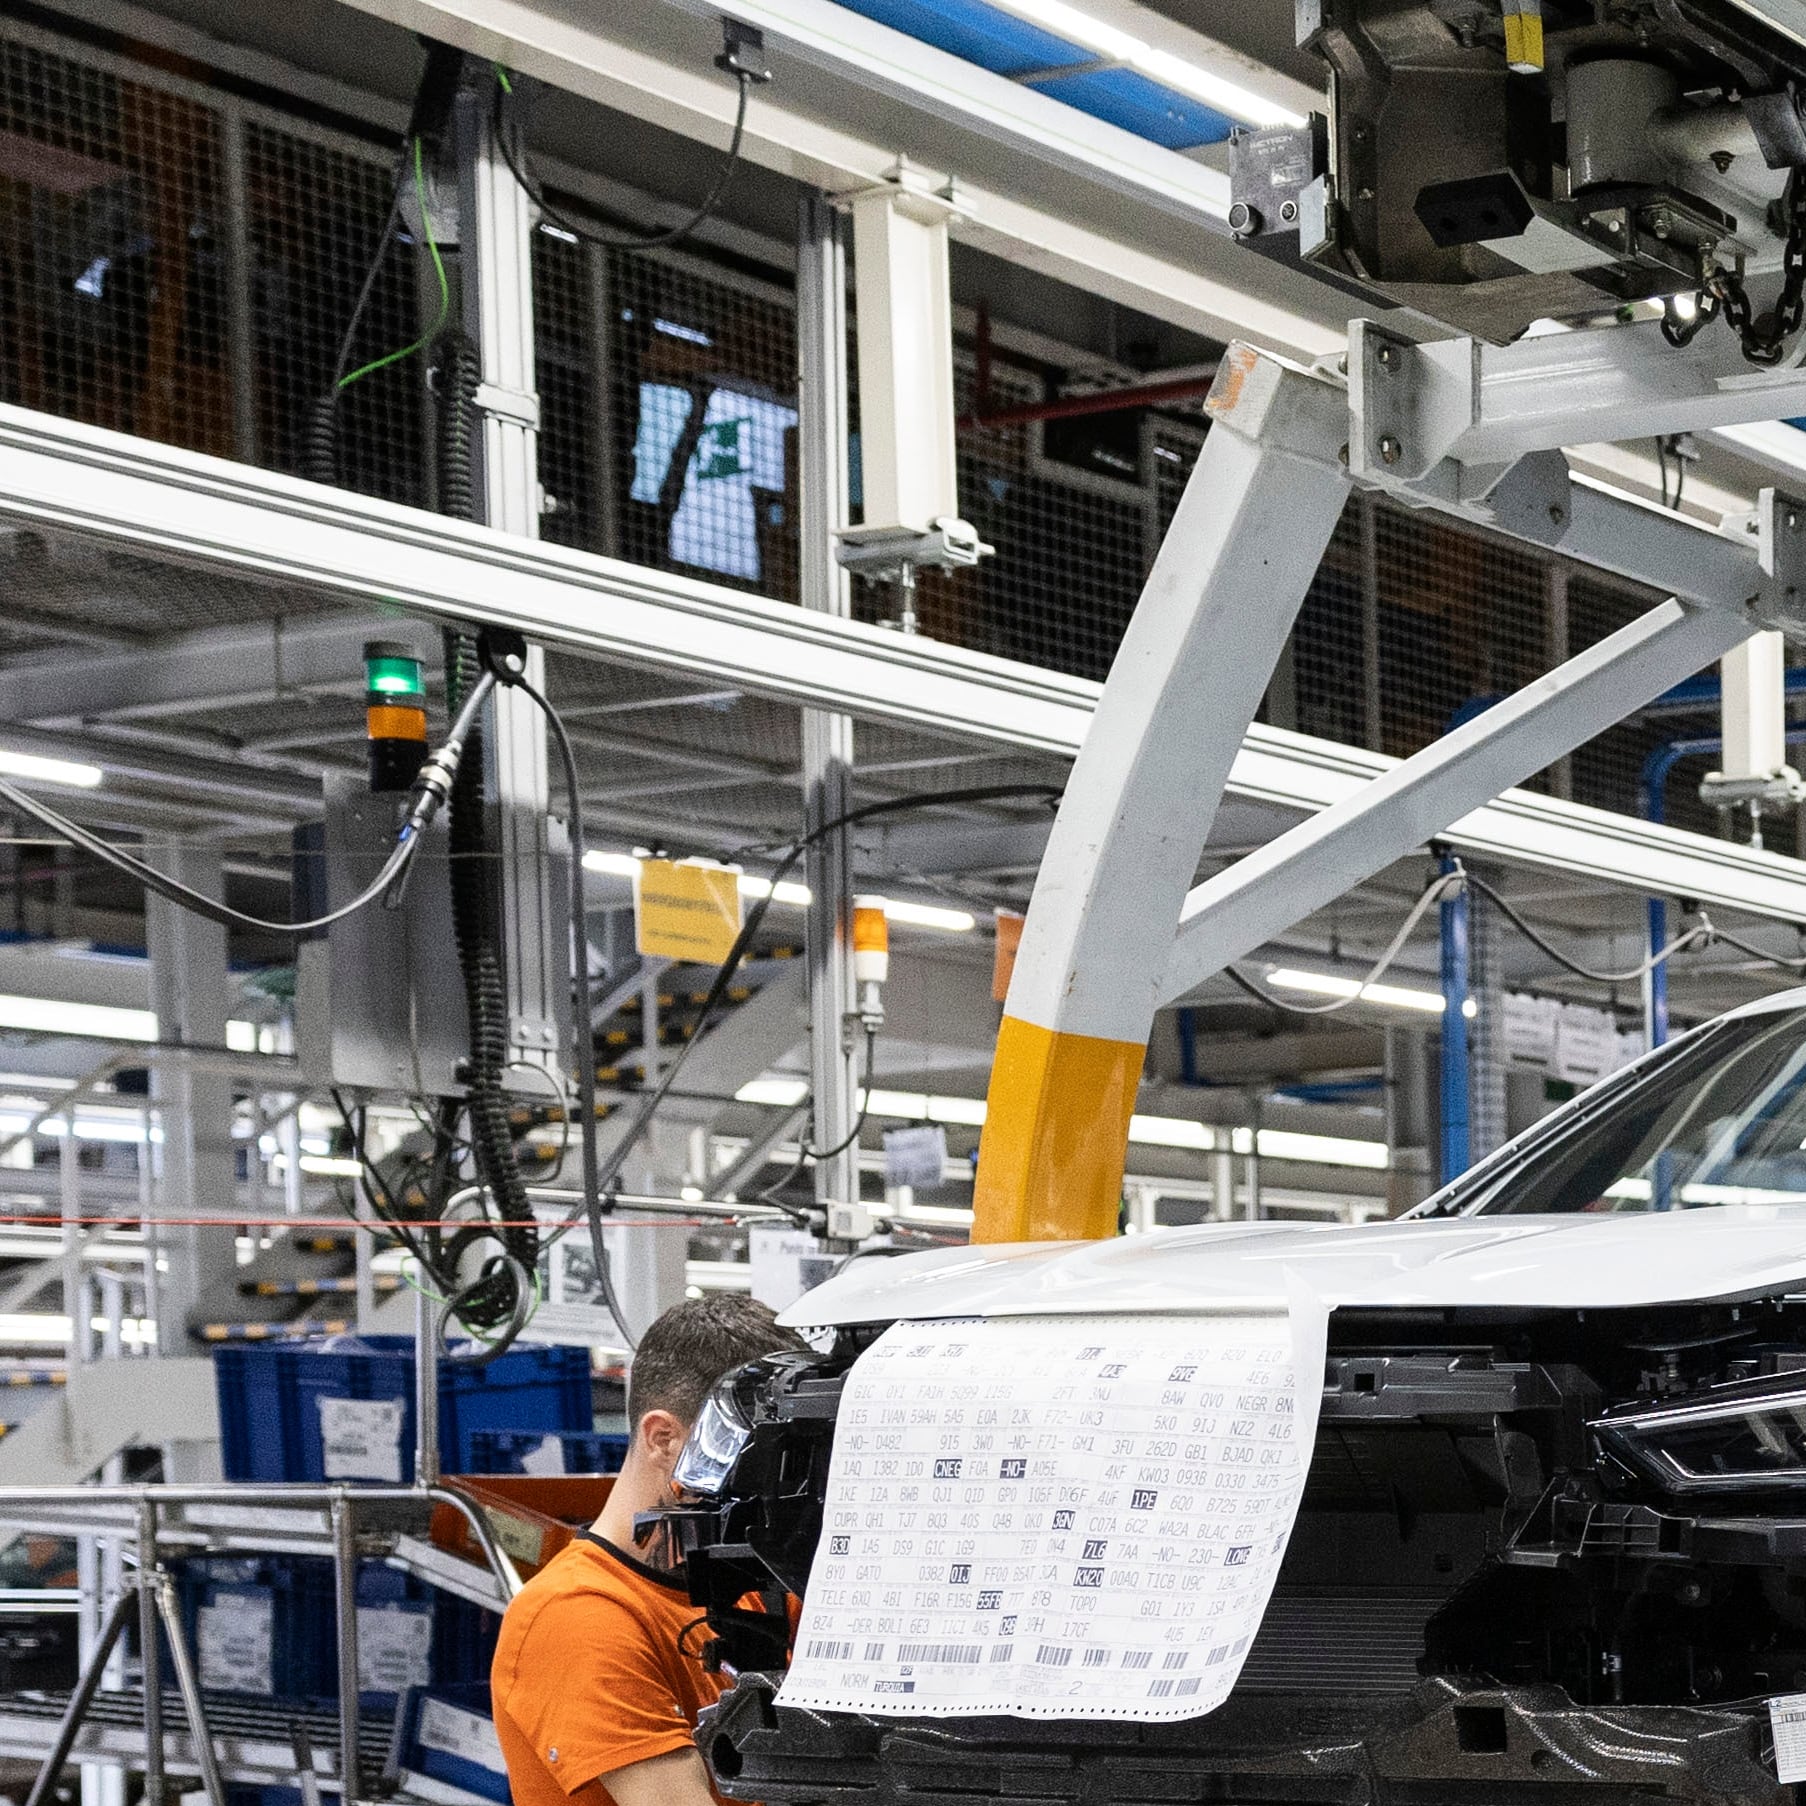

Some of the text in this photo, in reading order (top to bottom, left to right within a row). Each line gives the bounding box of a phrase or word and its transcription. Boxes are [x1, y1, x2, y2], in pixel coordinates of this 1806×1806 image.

[1236, 1394, 1268, 1412] NEGR
[1229, 1420, 1256, 1437] NZ2
[1267, 1423, 1294, 1440] 4L6
[1221, 1446, 1255, 1464] BJAD
[1205, 1497, 1239, 1515] B725
[834, 1511, 859, 1528] CUPR
[1197, 1522, 1230, 1540] BLAC
[821, 1589, 848, 1605] TELE
